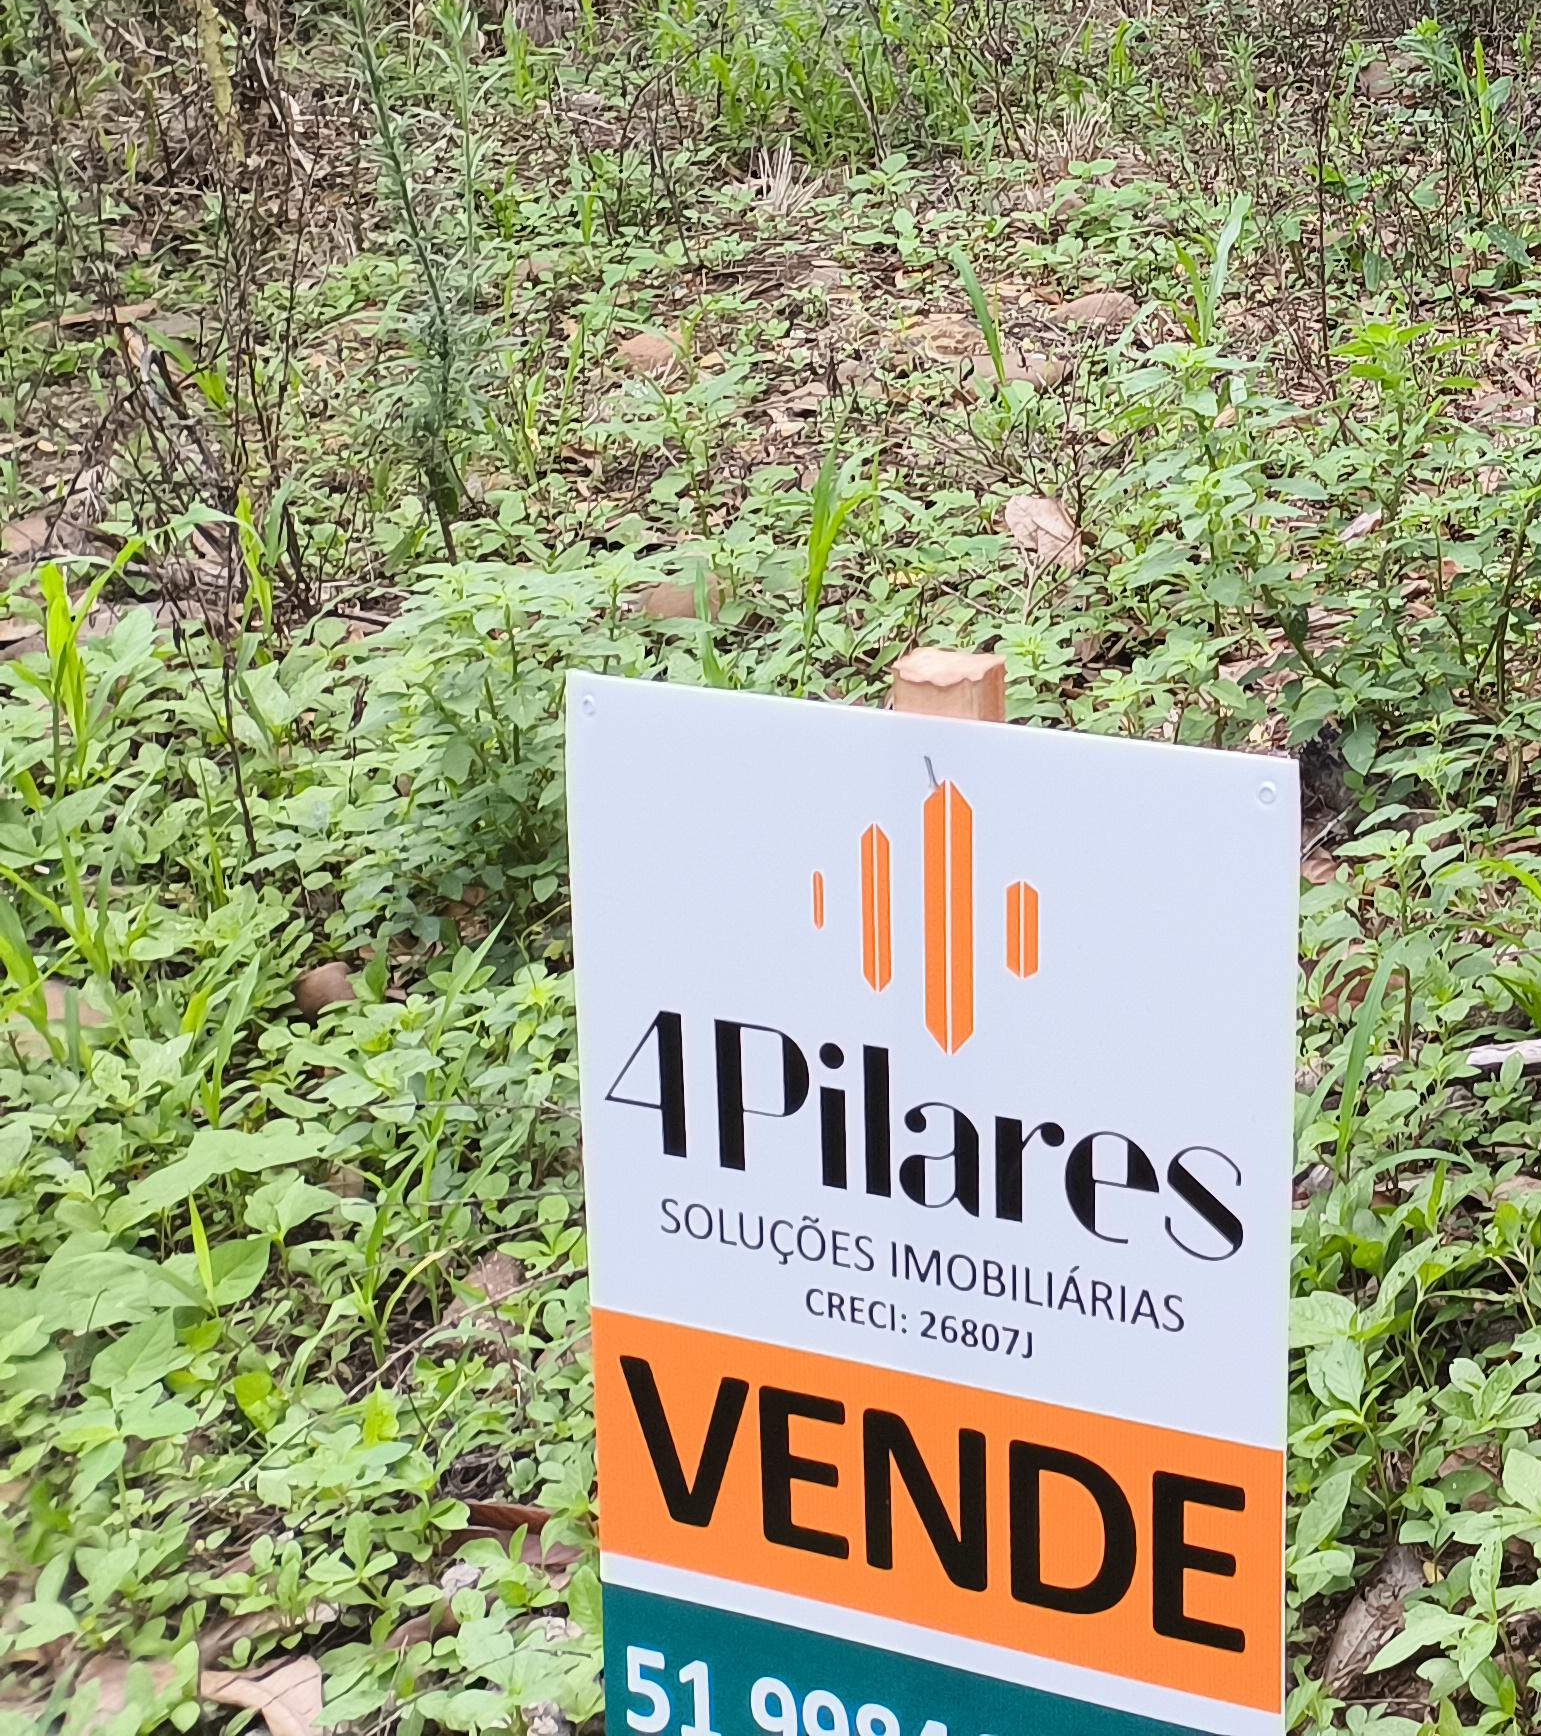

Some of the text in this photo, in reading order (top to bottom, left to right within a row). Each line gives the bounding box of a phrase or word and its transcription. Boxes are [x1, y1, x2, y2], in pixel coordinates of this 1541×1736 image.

[660, 1196, 1186, 1334] SOLUÇÕES IMOBILIÁRIAS
[805, 1287, 1034, 1360] CRECI: 26807J
[618, 1354, 1247, 1655] VENDE
[626, 1645, 723, 1736] 51
